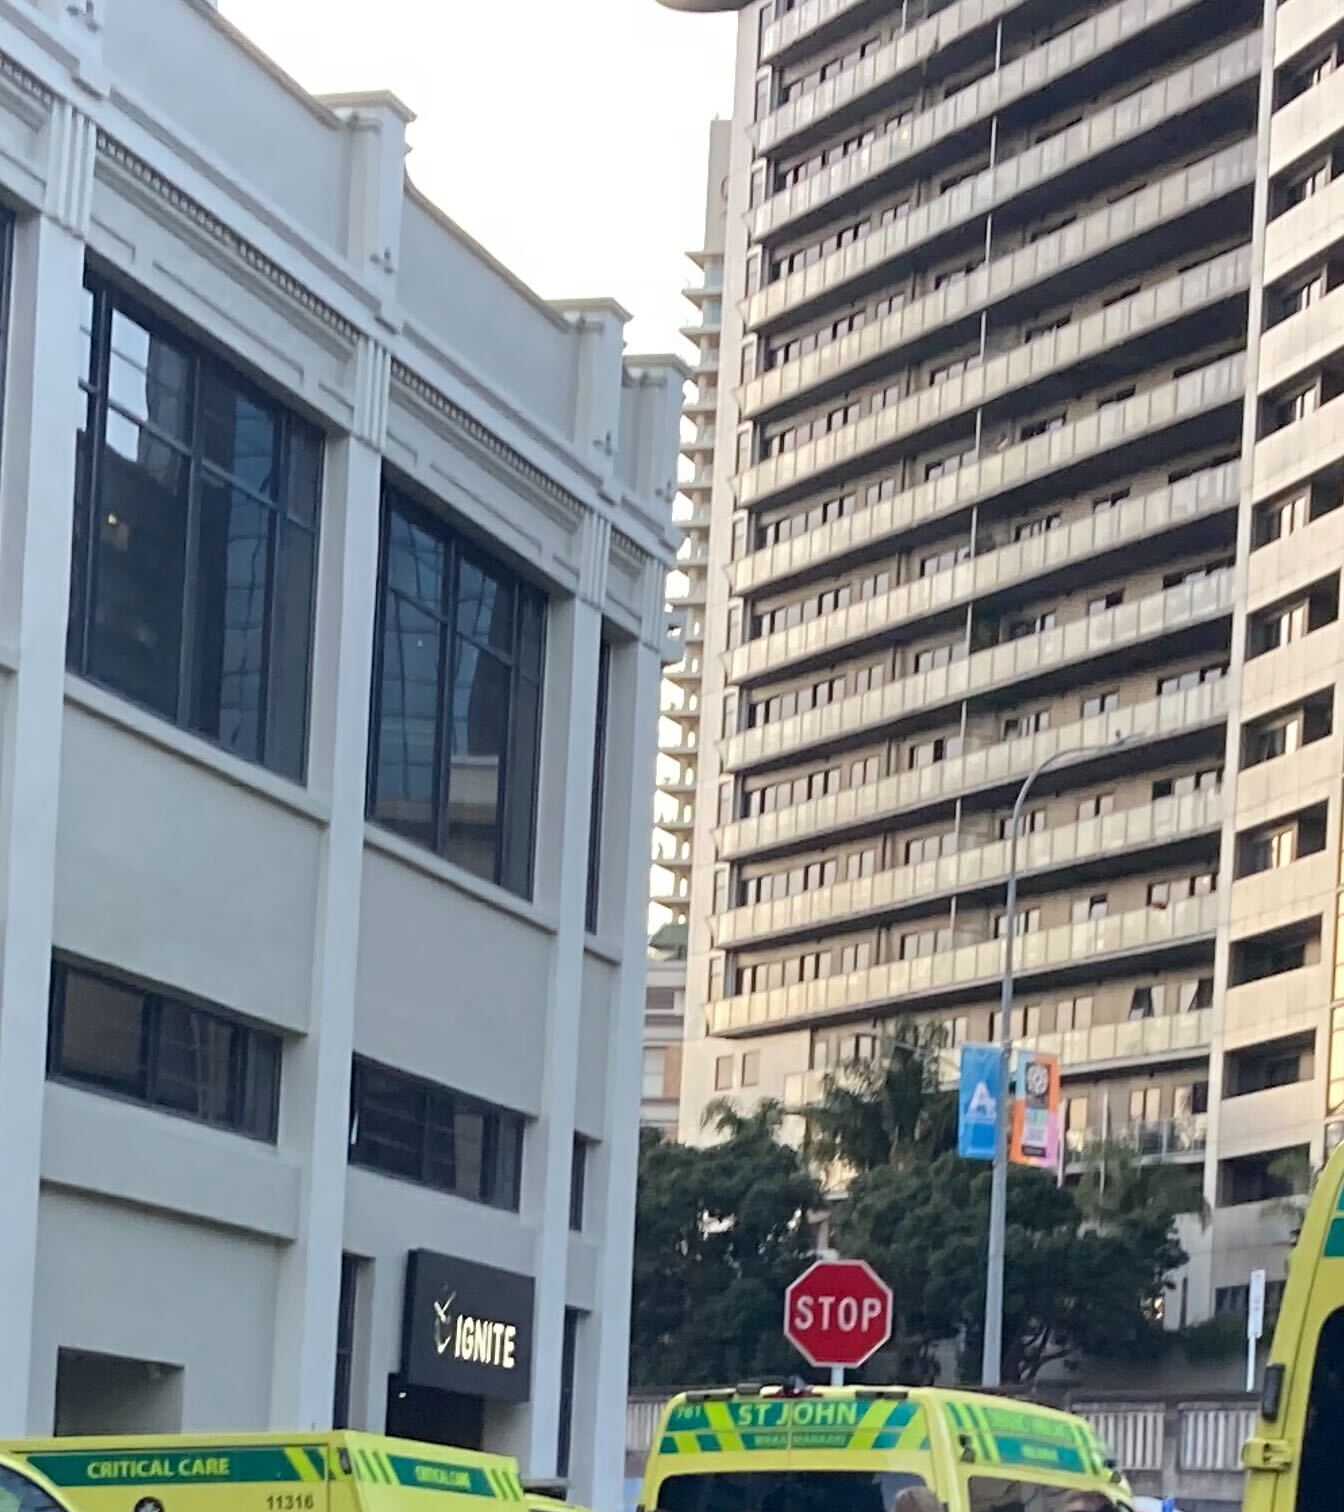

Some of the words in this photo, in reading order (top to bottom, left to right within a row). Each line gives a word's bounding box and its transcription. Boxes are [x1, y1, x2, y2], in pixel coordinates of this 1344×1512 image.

[794, 1295, 883, 1332] STOP
[455, 1314, 516, 1368] IGNITE
[738, 1404, 771, 1426] ST
[778, 1402, 857, 1426] JOHN
[87, 1458, 174, 1479] CRITICAL
[178, 1457, 230, 1477] CARE
[266, 1494, 314, 1511] 11316
